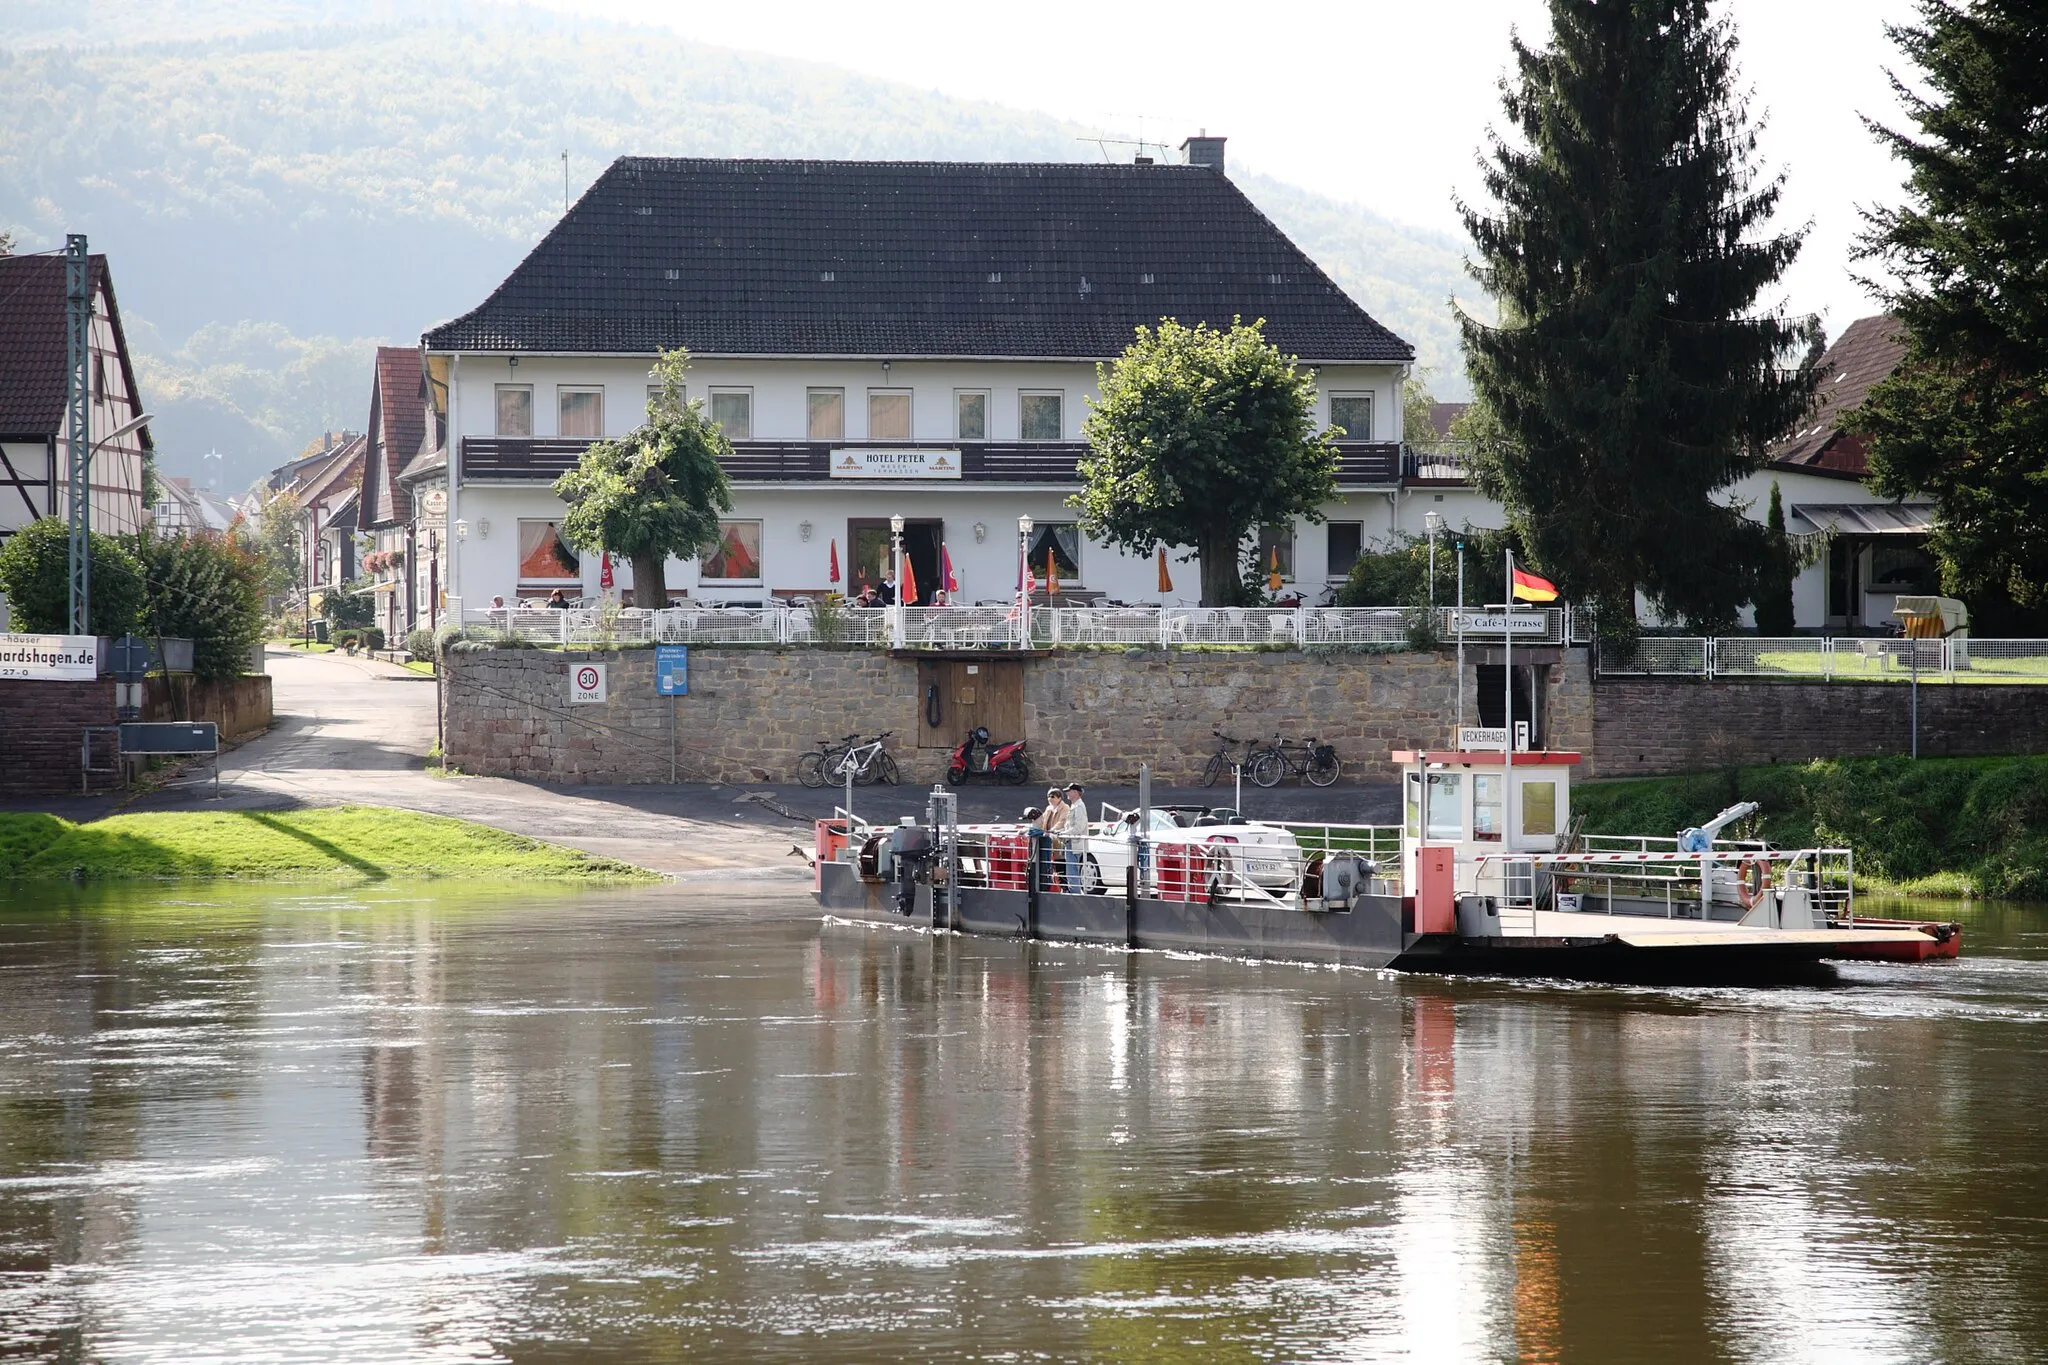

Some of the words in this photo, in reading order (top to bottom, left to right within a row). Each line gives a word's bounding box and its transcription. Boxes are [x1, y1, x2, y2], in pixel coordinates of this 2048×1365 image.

[866, 454, 894, 463] HOTEL
[897, 454, 925, 463] PETER
[581, 673, 595, 685] 30
[577, 692, 600, 700] ZONE
[1462, 730, 1508, 743] VECKERHAGEN
[1517, 724, 1526, 745] F
